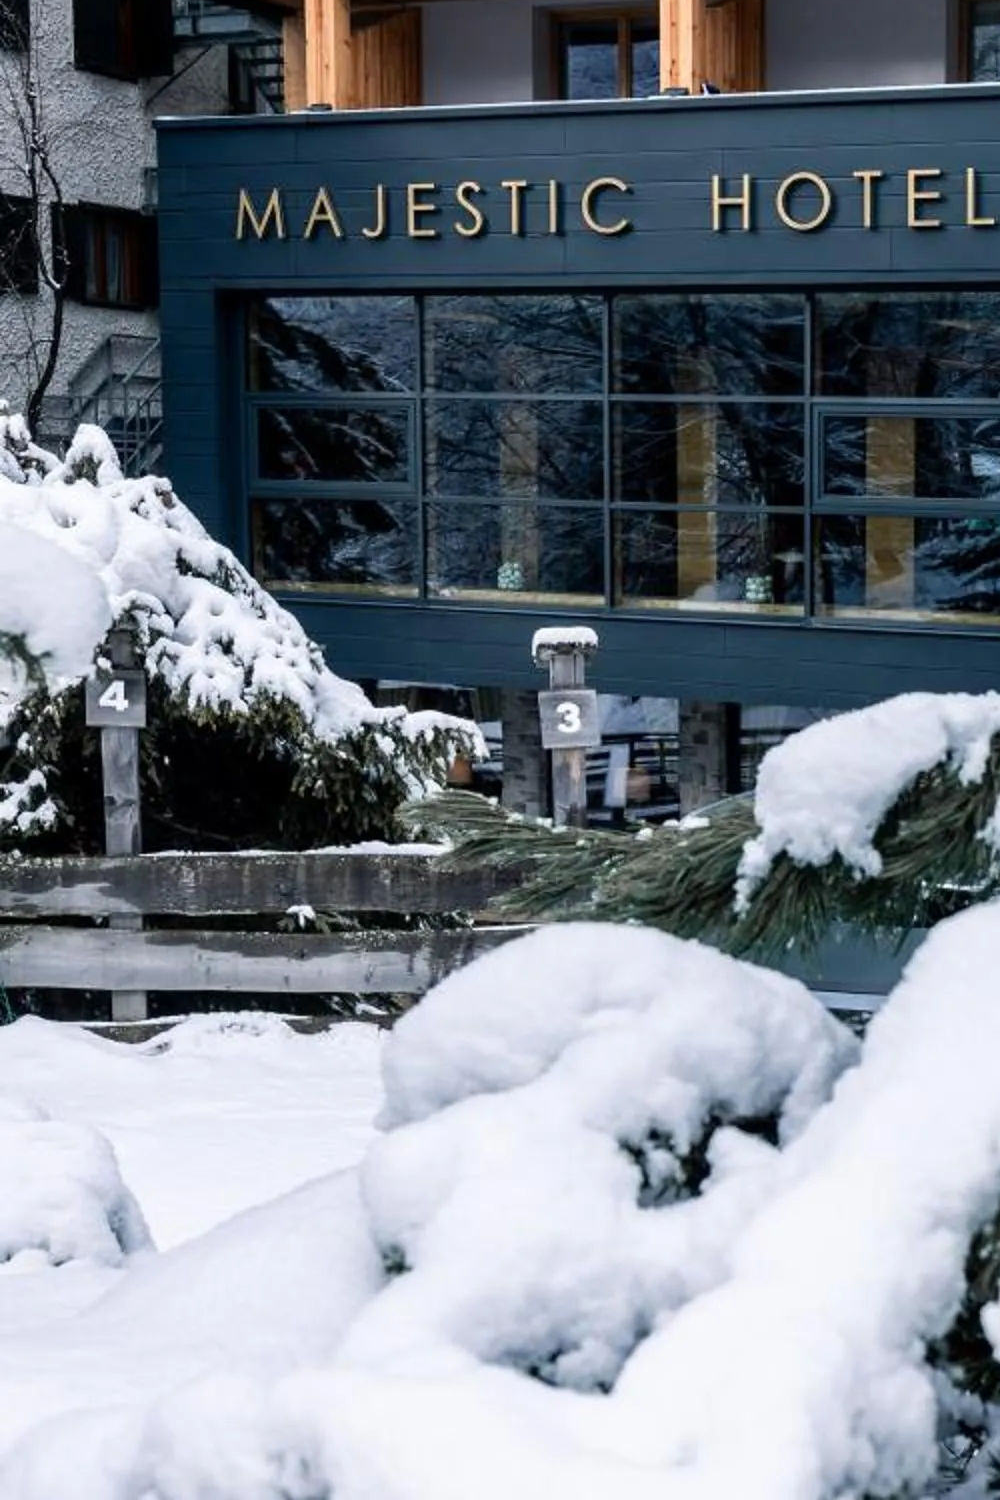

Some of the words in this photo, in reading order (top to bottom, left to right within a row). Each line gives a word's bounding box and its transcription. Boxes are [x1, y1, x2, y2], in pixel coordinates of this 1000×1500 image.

[235, 176, 631, 240] MAJESTIC
[711, 167, 996, 232] HOTEL
[99, 679, 129, 712] 4
[556, 702, 582, 733] 3
